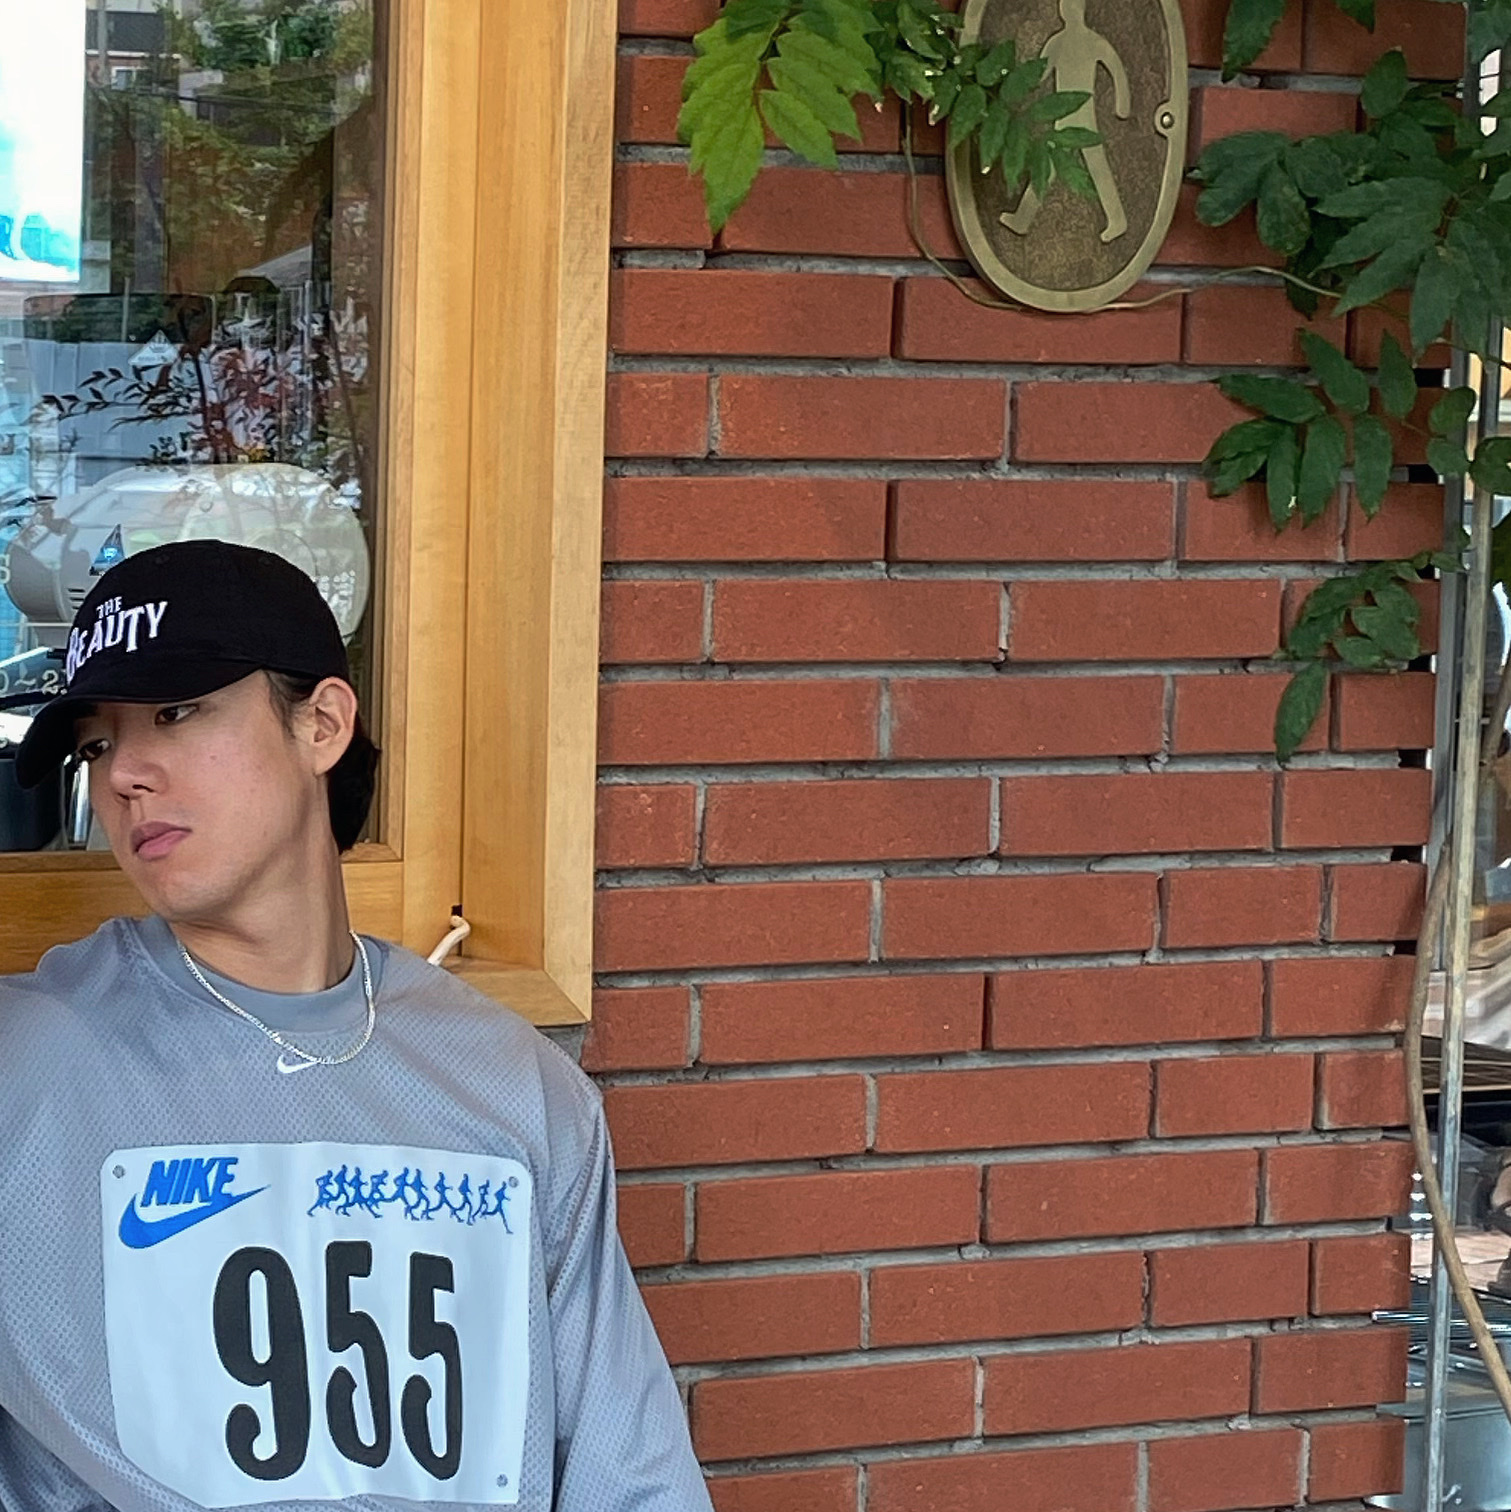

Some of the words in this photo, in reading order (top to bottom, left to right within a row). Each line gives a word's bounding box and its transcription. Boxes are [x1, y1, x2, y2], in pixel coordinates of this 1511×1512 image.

[96, 596, 122, 619] THE
[66, 601, 168, 686] BEAUTY
[141, 1157, 238, 1207] NIKE
[212, 1240, 463, 1481] 955
